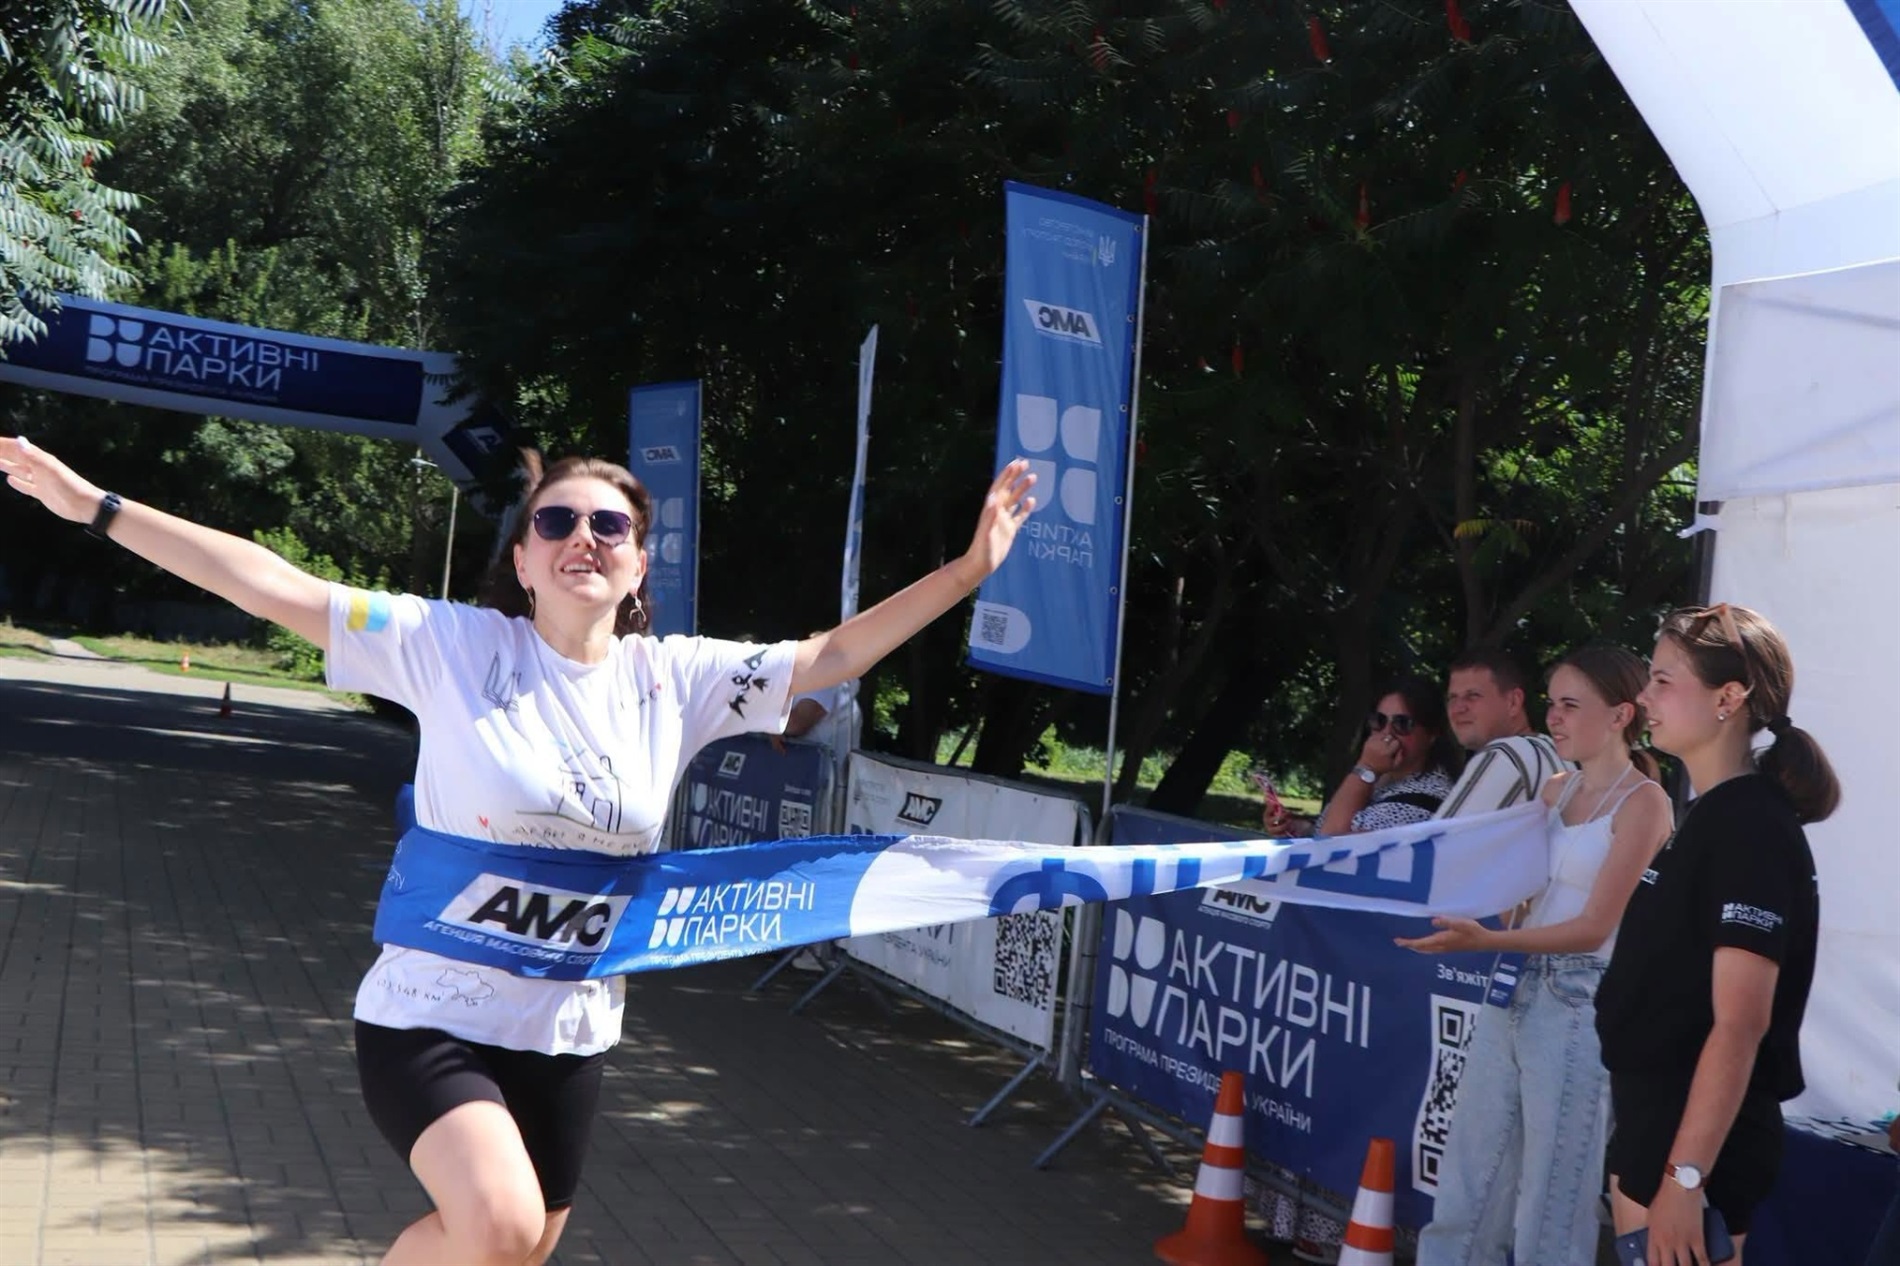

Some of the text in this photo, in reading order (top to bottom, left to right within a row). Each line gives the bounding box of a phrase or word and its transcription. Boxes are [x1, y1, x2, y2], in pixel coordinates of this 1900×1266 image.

[145, 347, 281, 391] ПАРКИ
[149, 327, 319, 372] АКТИВНІ
[691, 881, 816, 915] АКТИВНІ
[683, 912, 782, 947] ПАРКИ
[1168, 928, 1371, 1049] АКТИВНІ
[1437, 963, 1490, 989] Зв'яжіт
[1154, 984, 1317, 1099] ПАРКИ
[1103, 1027, 1159, 1069] ПРОГРАМА
[1250, 1091, 1313, 1135] УКРАЇНИ
